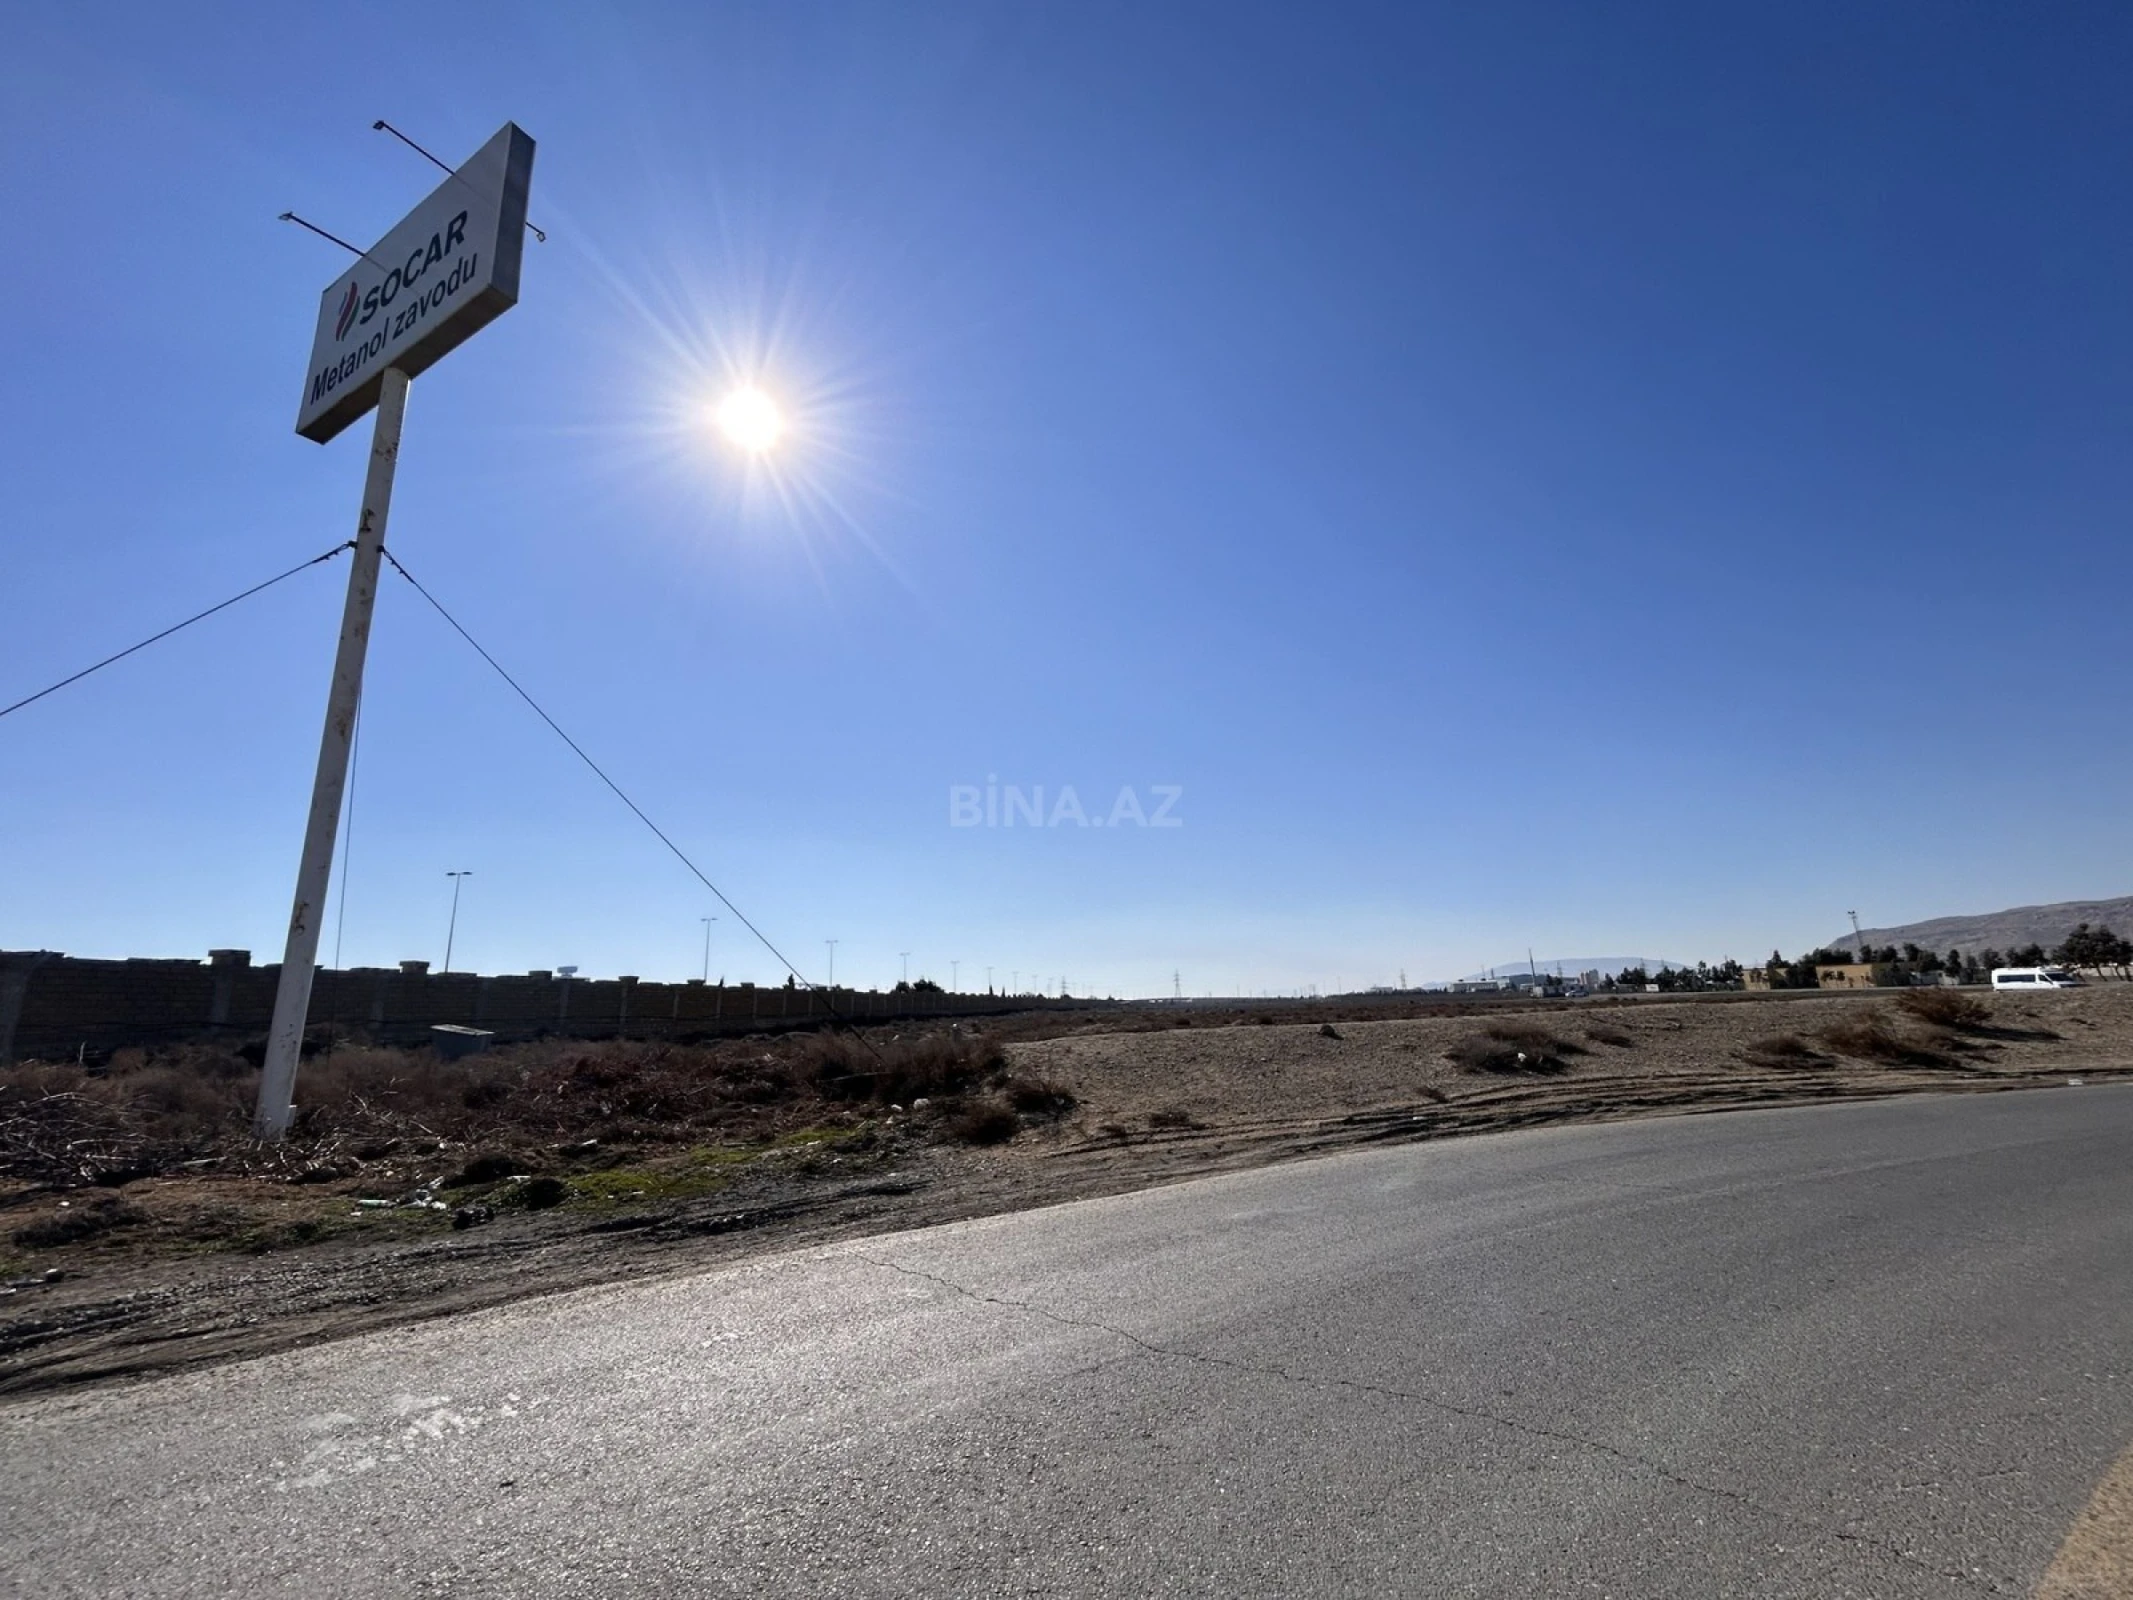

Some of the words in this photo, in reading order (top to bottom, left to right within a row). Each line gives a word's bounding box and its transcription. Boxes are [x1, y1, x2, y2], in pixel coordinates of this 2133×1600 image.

[310, 317, 390, 405] Metanol
[392, 253, 478, 341] zavodu
[359, 210, 468, 326] SOCAR
